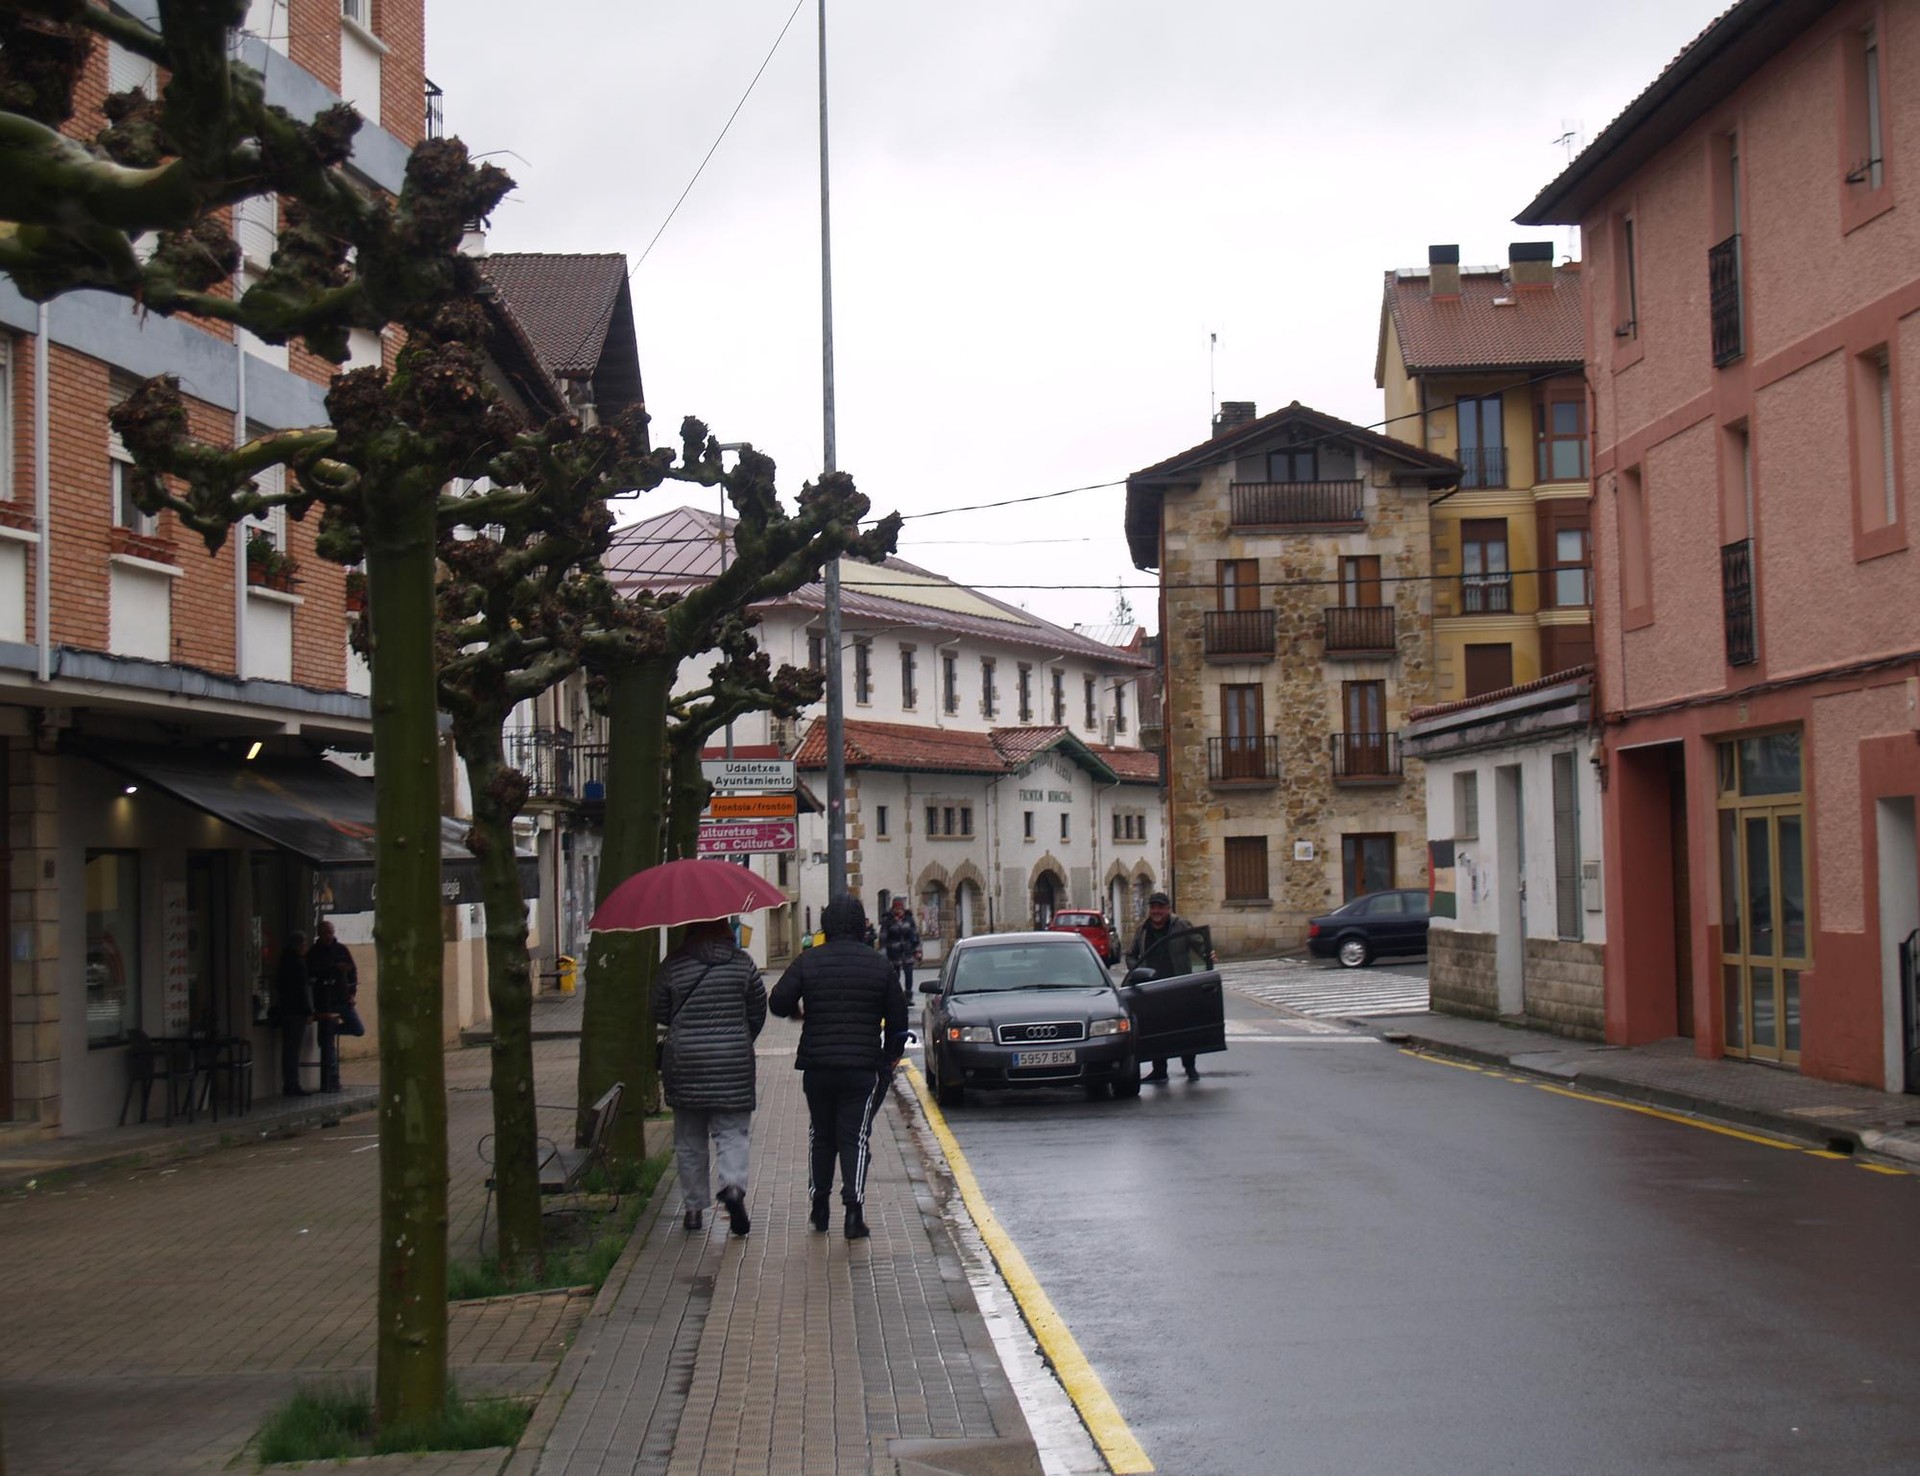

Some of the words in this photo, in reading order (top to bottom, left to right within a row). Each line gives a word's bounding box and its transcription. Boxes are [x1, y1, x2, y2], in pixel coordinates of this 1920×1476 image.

[725, 763, 781, 773] Udaletxea
[715, 776, 792, 787] Ayuntamiento
[698, 827, 758, 838] ulturetxea
[712, 840, 727, 851] de
[733, 839, 774, 849] Cultura
[1020, 1052, 1048, 1065] 5957
[1052, 1050, 1073, 1063] BSK
